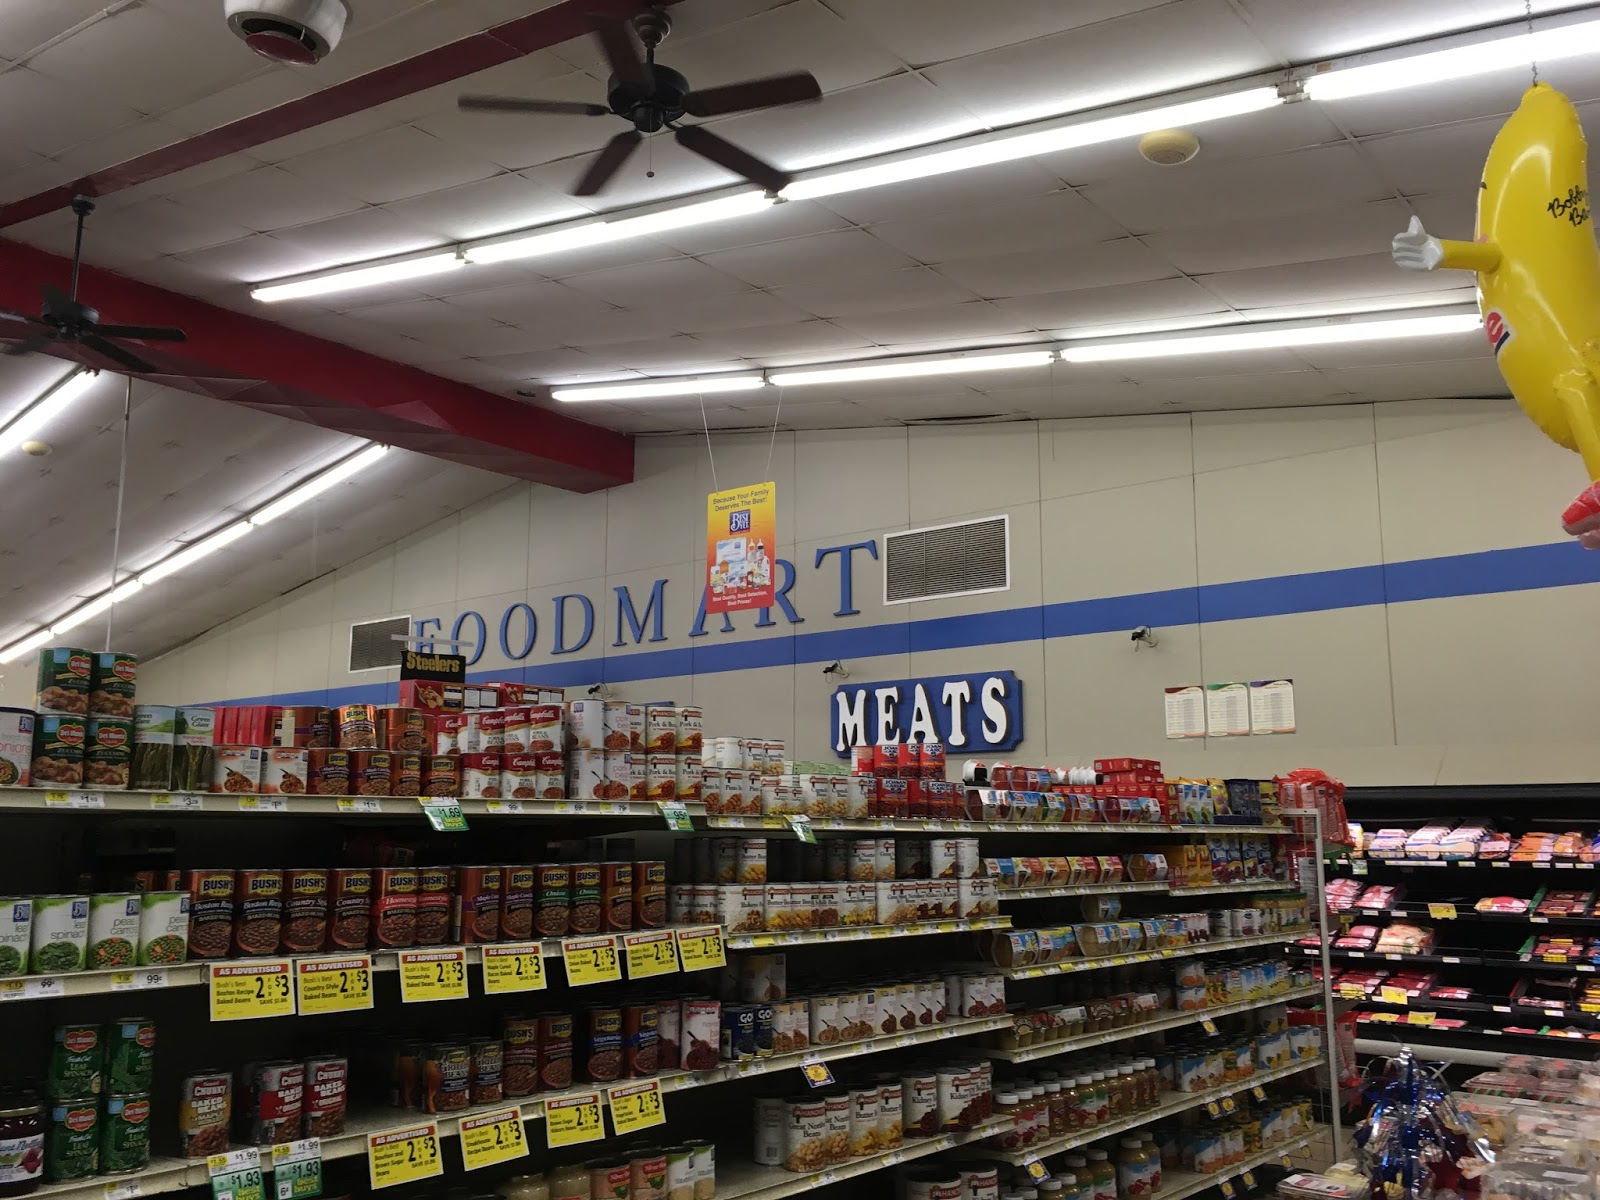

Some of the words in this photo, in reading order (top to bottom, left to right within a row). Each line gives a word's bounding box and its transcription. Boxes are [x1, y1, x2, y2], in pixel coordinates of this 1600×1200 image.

[713, 495, 735, 504] Because
[737, 492, 749, 500] Your
[750, 489, 769, 498] Family
[715, 502, 740, 511] Deserves
[406, 651, 460, 673] Steelers
[346, 709, 368, 718] BUSH'S
[835, 677, 1009, 752] MEATS
[438, 807, 461, 818] $1.69
[543, 871, 568, 882] BUSH'S
[577, 870, 600, 881] BUSH'S
[203, 879, 234, 892] BUSH'S
[251, 879, 282, 890] BUSH'S
[294, 877, 326, 890] BUSH'S
[545, 889, 566, 897] Onion
[579, 888, 598, 896] Onion
[654, 943, 661, 960] 2
[665, 941, 675, 958] $3
[702, 938, 709, 954] 2
[712, 936, 721, 952] $3
[593, 949, 600, 967] 2
[605, 947, 616, 965] $3
[219, 967, 231, 976] AS
[231, 965, 282, 975] ADVERTISED
[306, 964, 317, 972] AS
[317, 960, 363, 970] ADVERTISED
[436, 962, 444, 982] 2
[452, 961, 463, 981] $3
[515, 956, 523, 975] 2
[529, 955, 541, 974] $3
[255, 976, 265, 998] 2
[275, 974, 289, 997] $3
[303, 984, 324, 992] Country
[339, 971, 348, 993] 2
[357, 969, 369, 990] $3
[236, 988, 254, 996] Recipe
[637, 1094, 645, 1113] 2
[649, 1091, 660, 1109] $3
[575, 1106, 583, 1126] 2
[589, 1104, 600, 1123] $3
[494, 1124, 503, 1145] 2
[508, 1120, 521, 1140] $3
[297, 1140, 319, 1151] $1.99
[407, 1140, 416, 1162] 2
[424, 1136, 436, 1158] $3
[235, 1150, 258, 1161] $1.99
[292, 1161, 320, 1178] $1.93
[231, 1170, 260, 1188] $1.93
